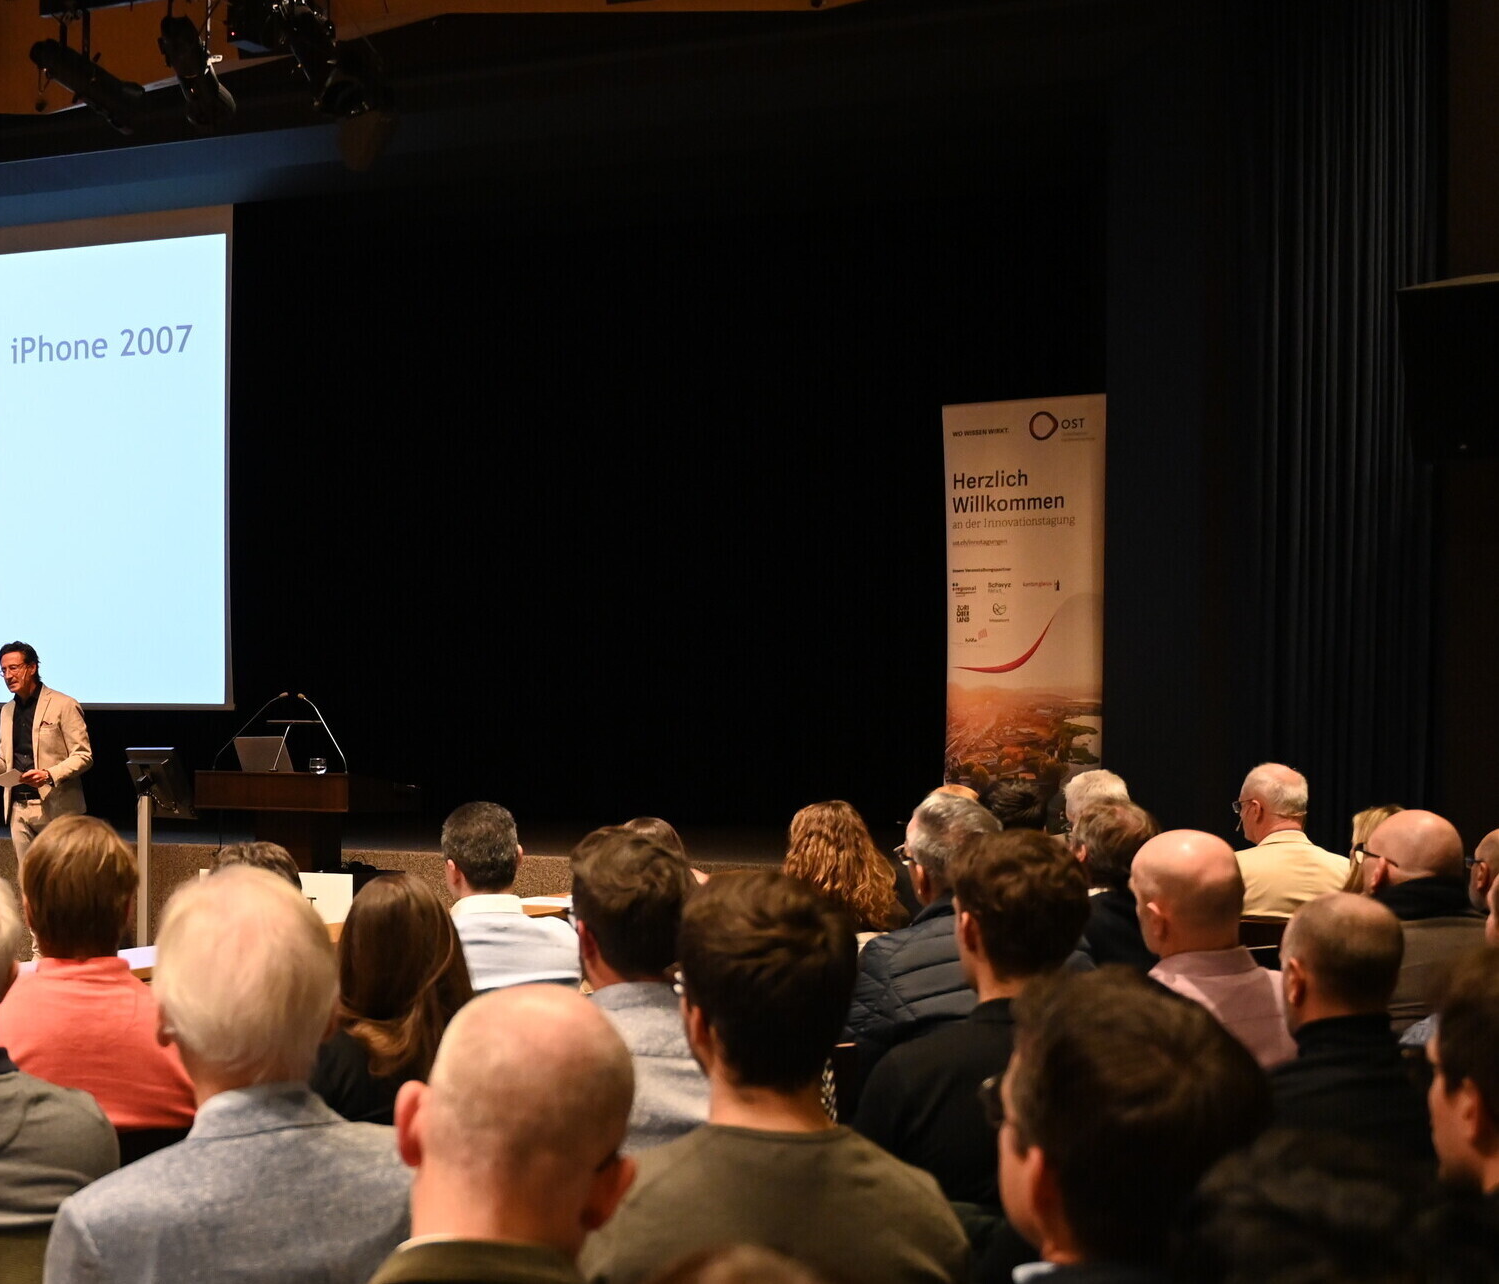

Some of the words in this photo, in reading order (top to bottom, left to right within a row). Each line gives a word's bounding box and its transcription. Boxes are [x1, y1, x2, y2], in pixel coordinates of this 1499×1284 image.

[11, 335, 108, 364] iPhone
[120, 325, 193, 357] 2007
[1061, 418, 1085, 430] OST
[953, 469, 1028, 490] Herzlich
[952, 495, 1065, 513] Willkommen
[965, 519, 981, 529] der
[983, 515, 1076, 529] Innovationstagung
[988, 581, 1012, 589] Schwyz
